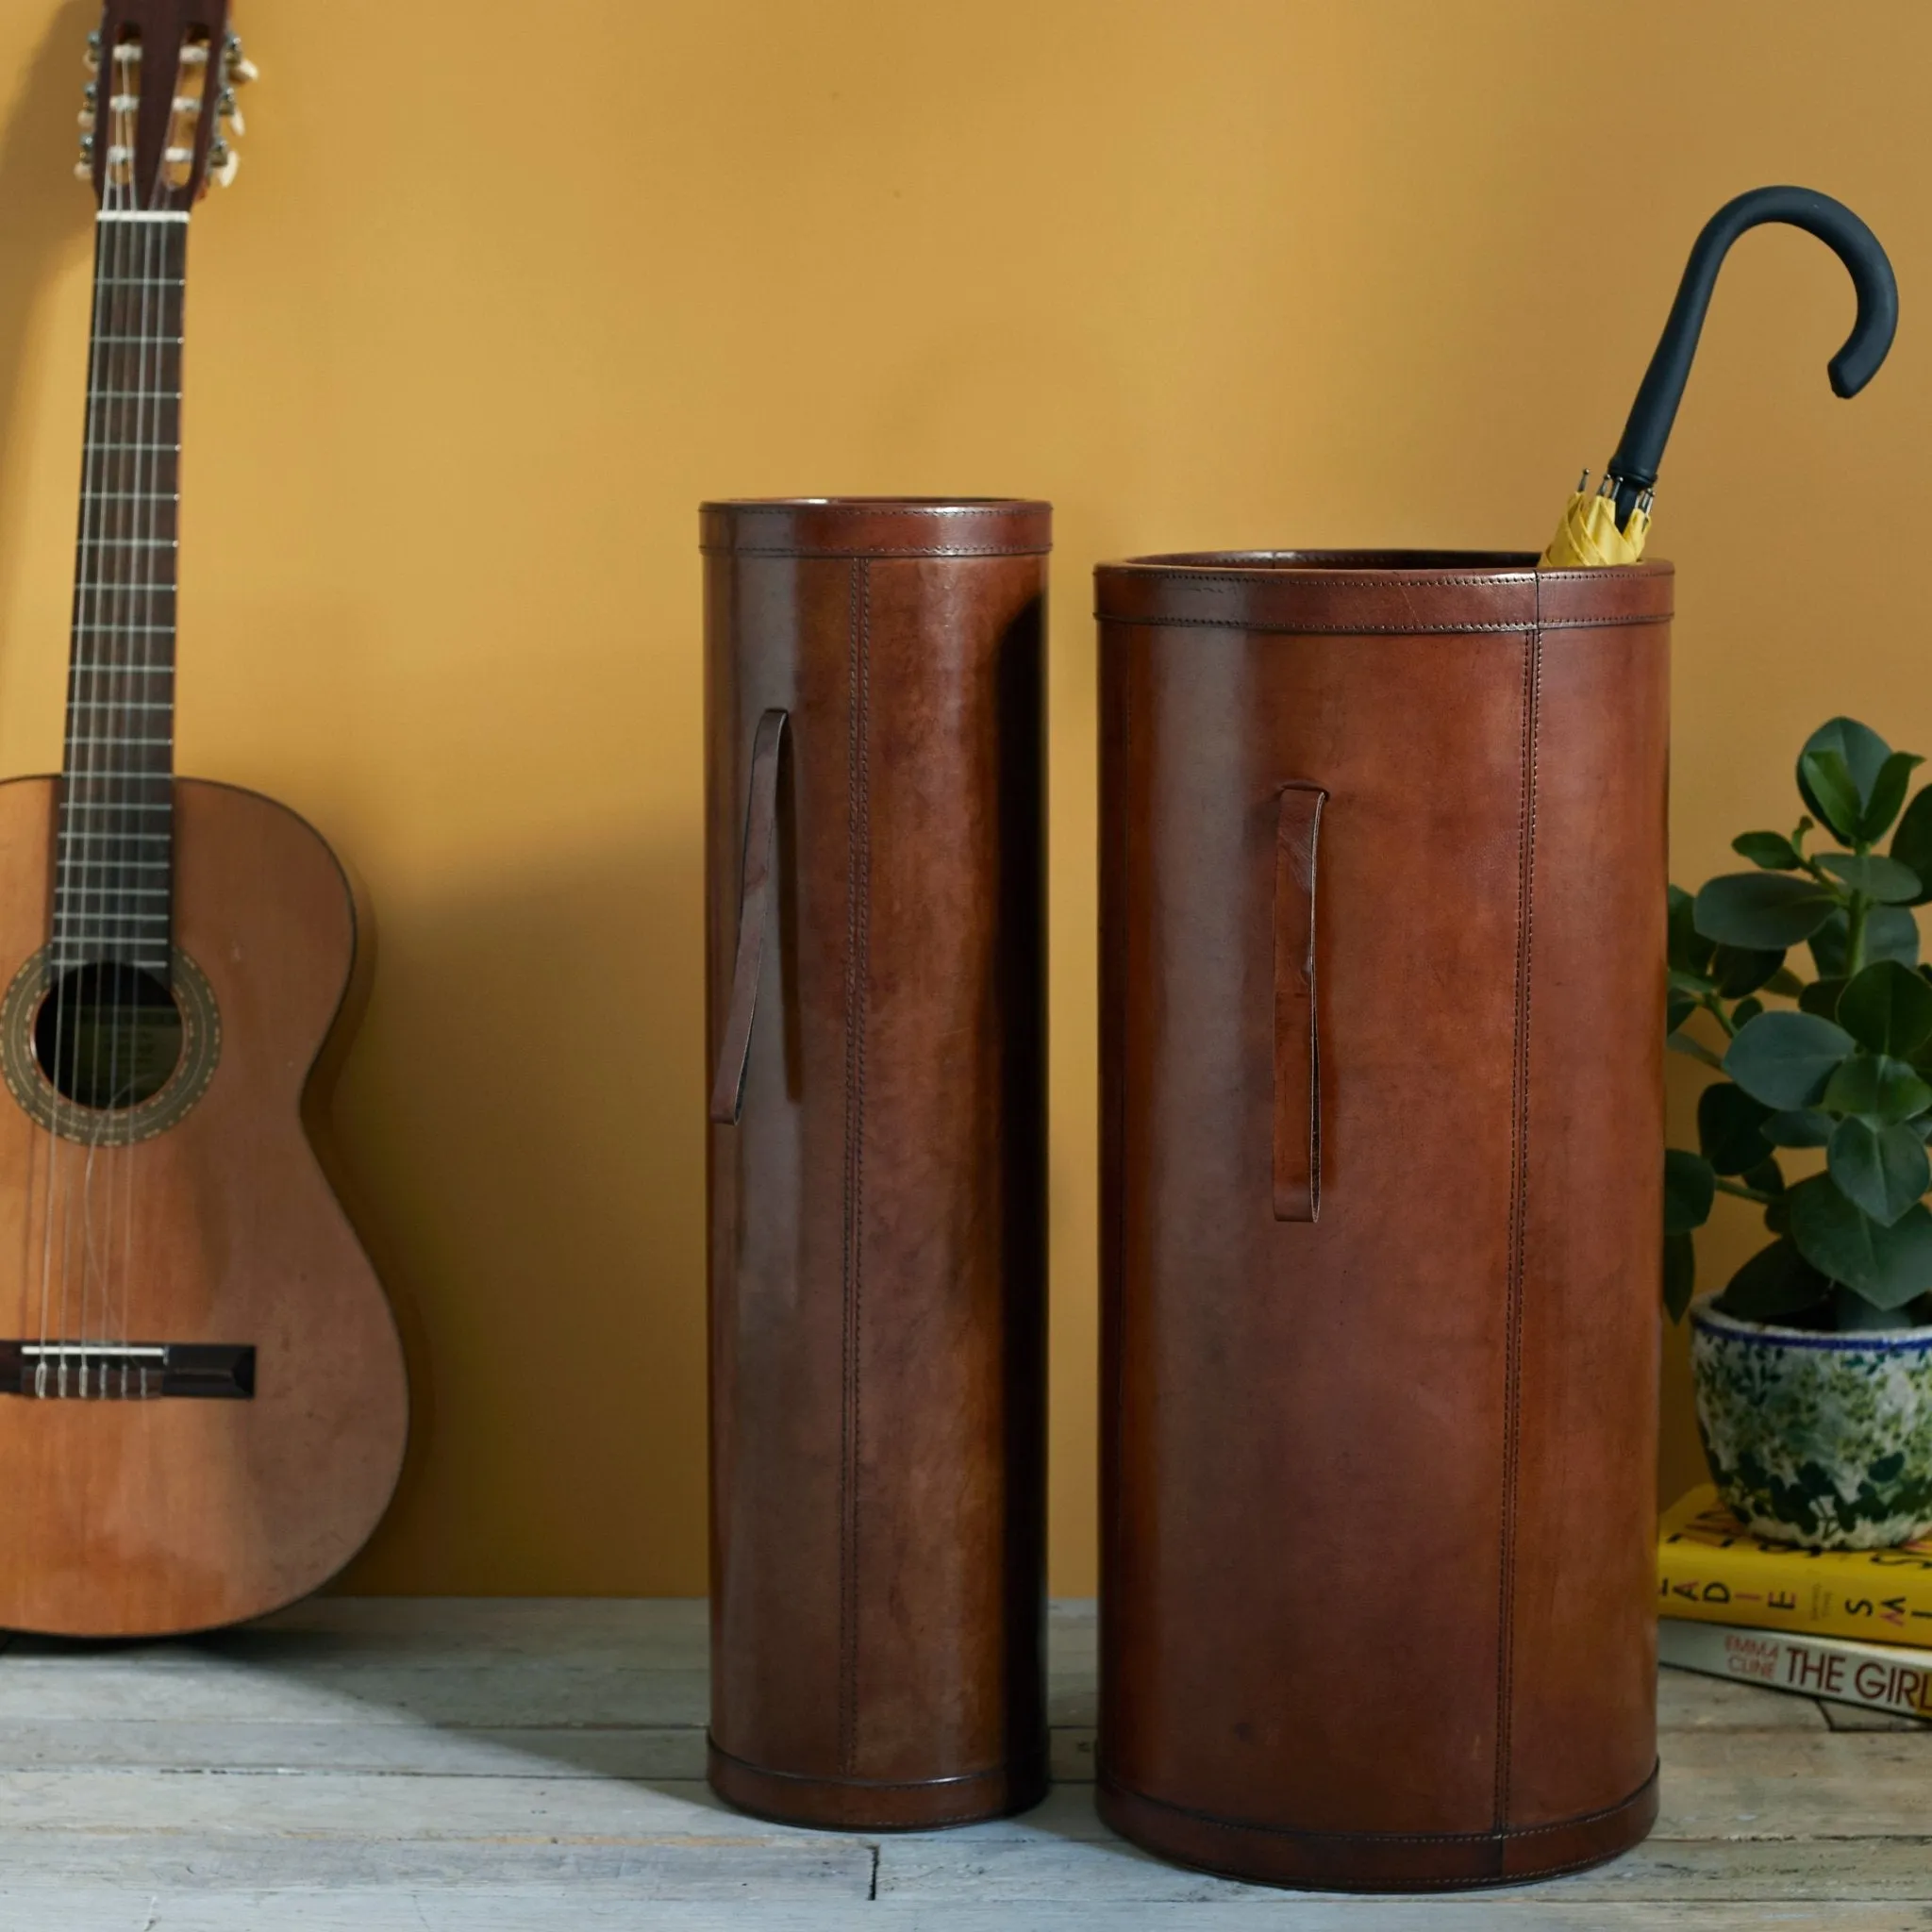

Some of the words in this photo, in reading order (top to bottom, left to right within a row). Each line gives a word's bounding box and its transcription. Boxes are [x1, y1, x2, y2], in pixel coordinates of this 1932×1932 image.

[1724, 1634, 1779, 1658] EMMA
[1727, 1655, 1775, 1679] CLINE
[1787, 1646, 1846, 1693] THE
[1855, 1661, 1932, 1711] GIRL
